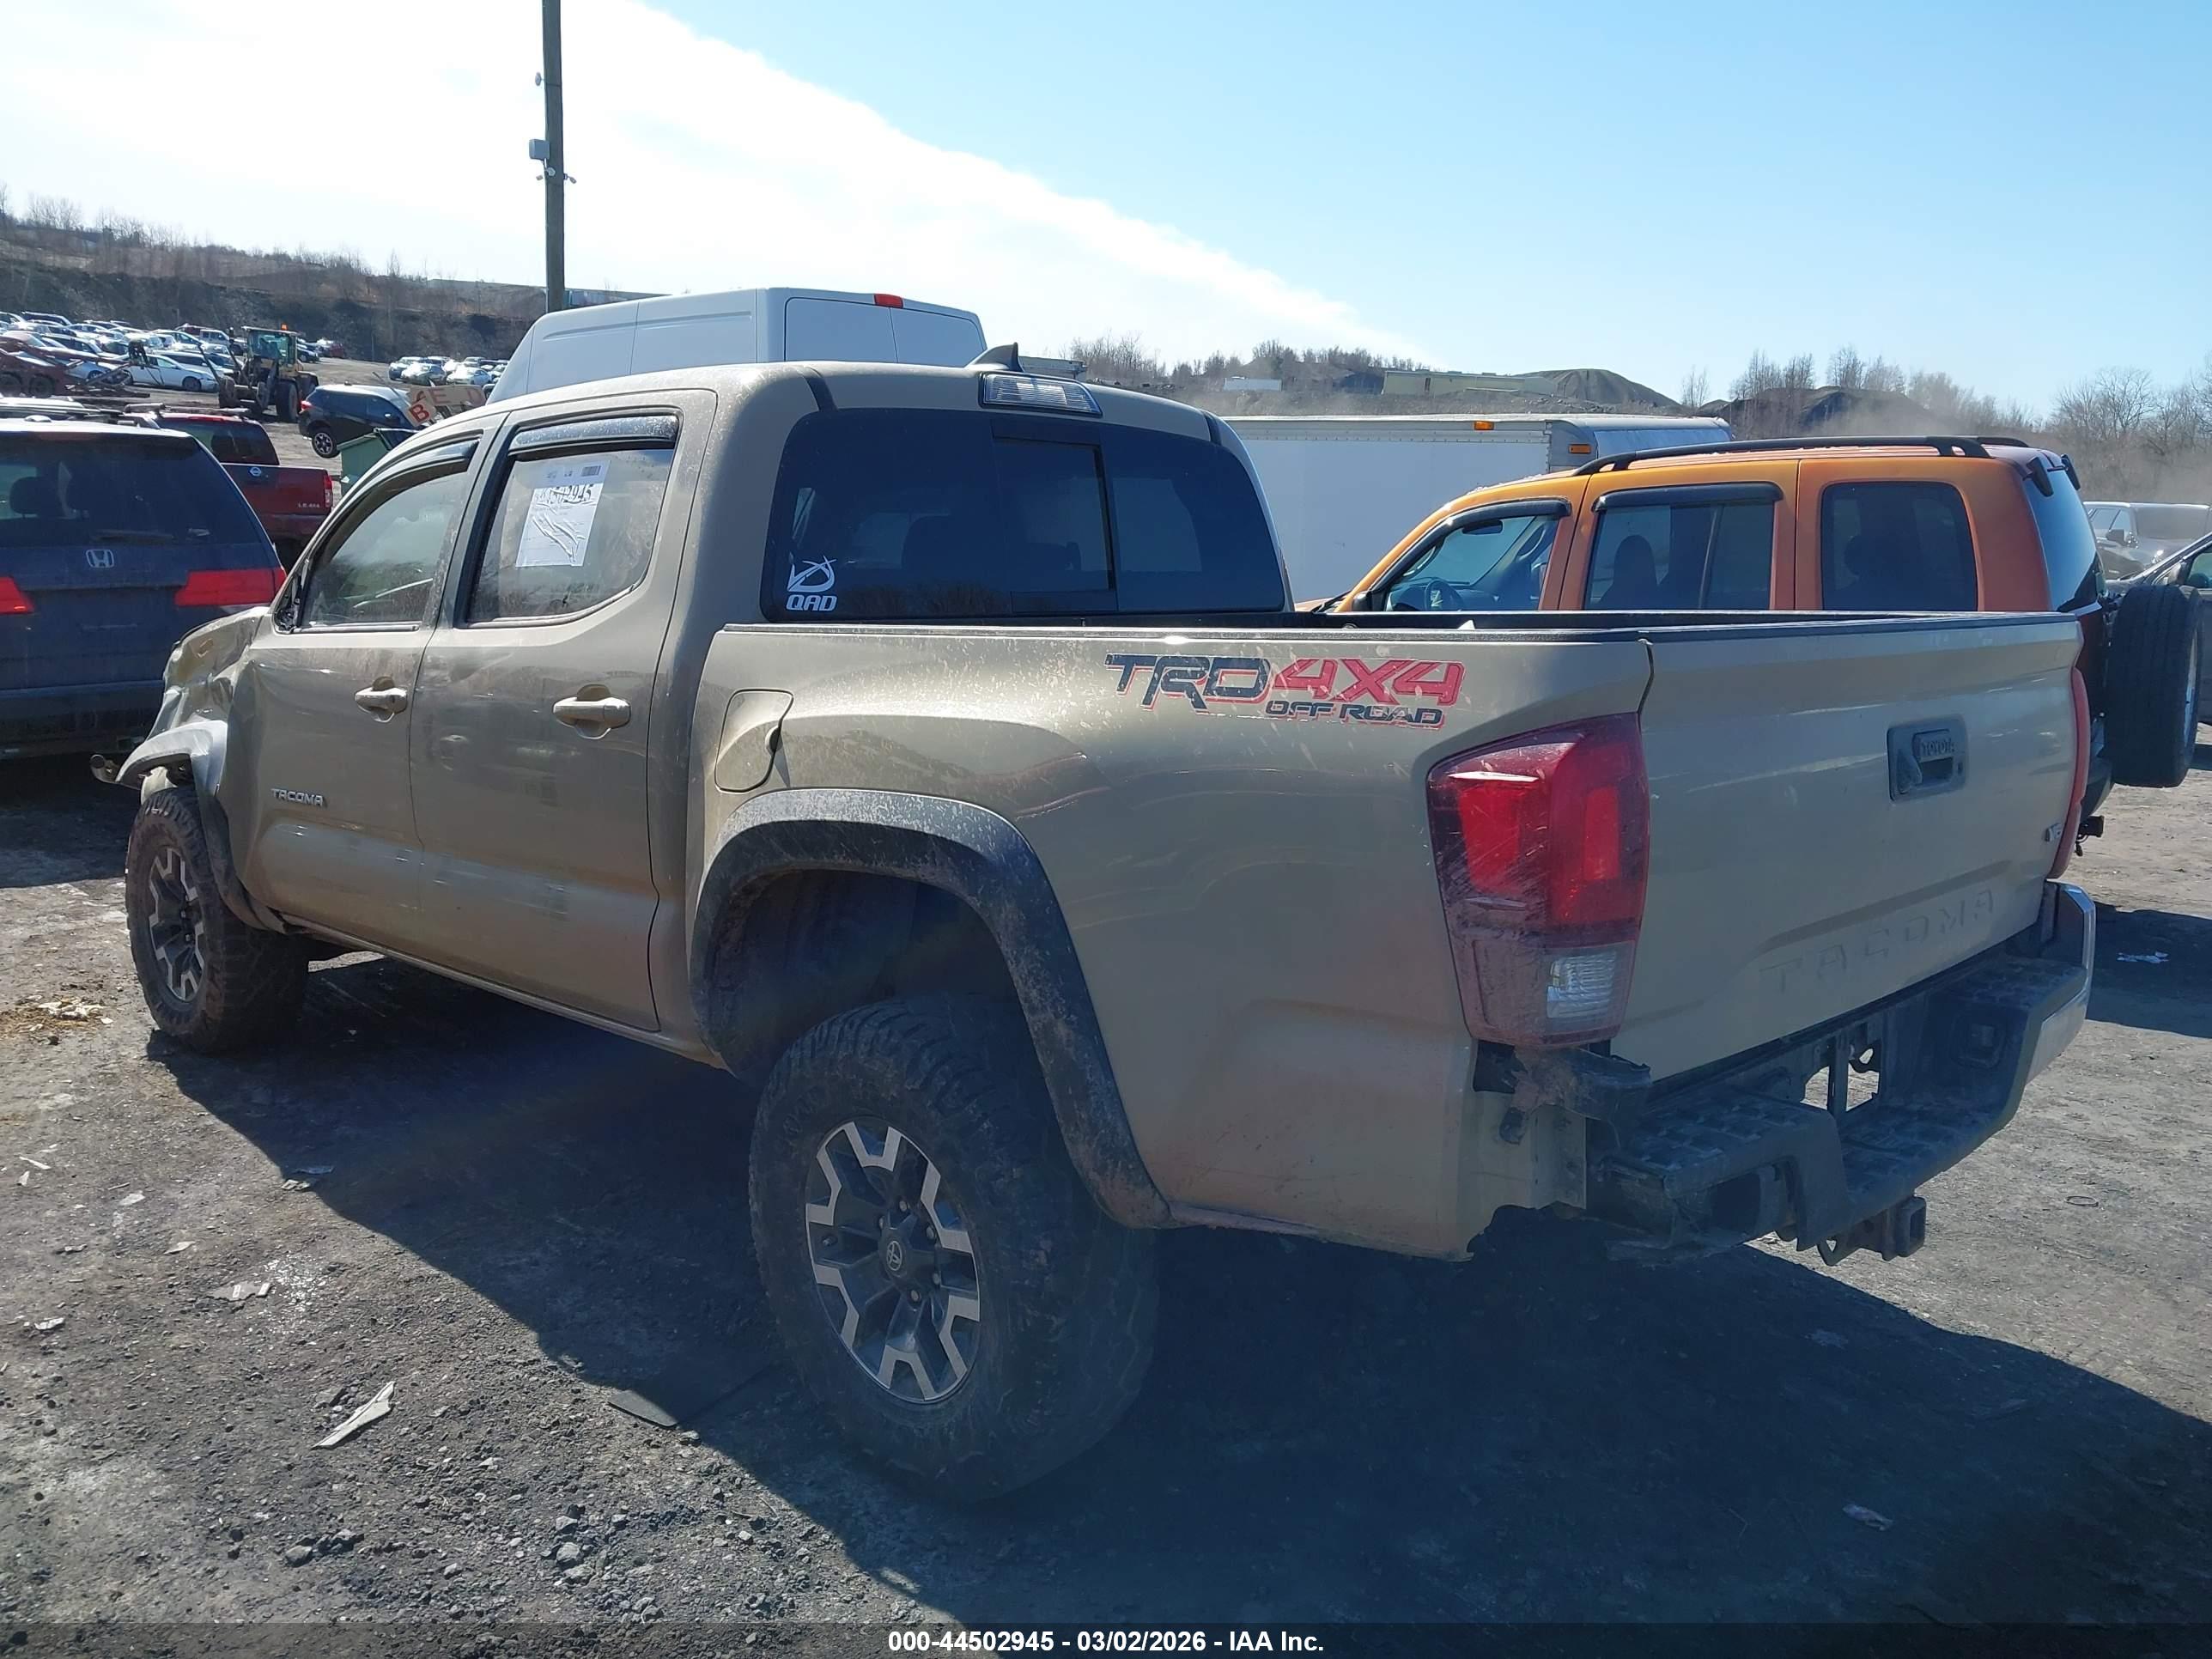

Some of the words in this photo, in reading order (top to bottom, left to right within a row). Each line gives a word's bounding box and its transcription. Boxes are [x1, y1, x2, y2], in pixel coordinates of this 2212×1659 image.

[409, 404, 429, 422] B
[786, 594, 837, 611] QAD
[1104, 653, 1274, 714] TRD
[1273, 658, 1465, 707] 4X4
[1265, 700, 1338, 721] OFF
[1340, 704, 1446, 730] ROAD
[270, 788, 324, 806] TACOMA
[1759, 888, 1994, 994] TACOMA
